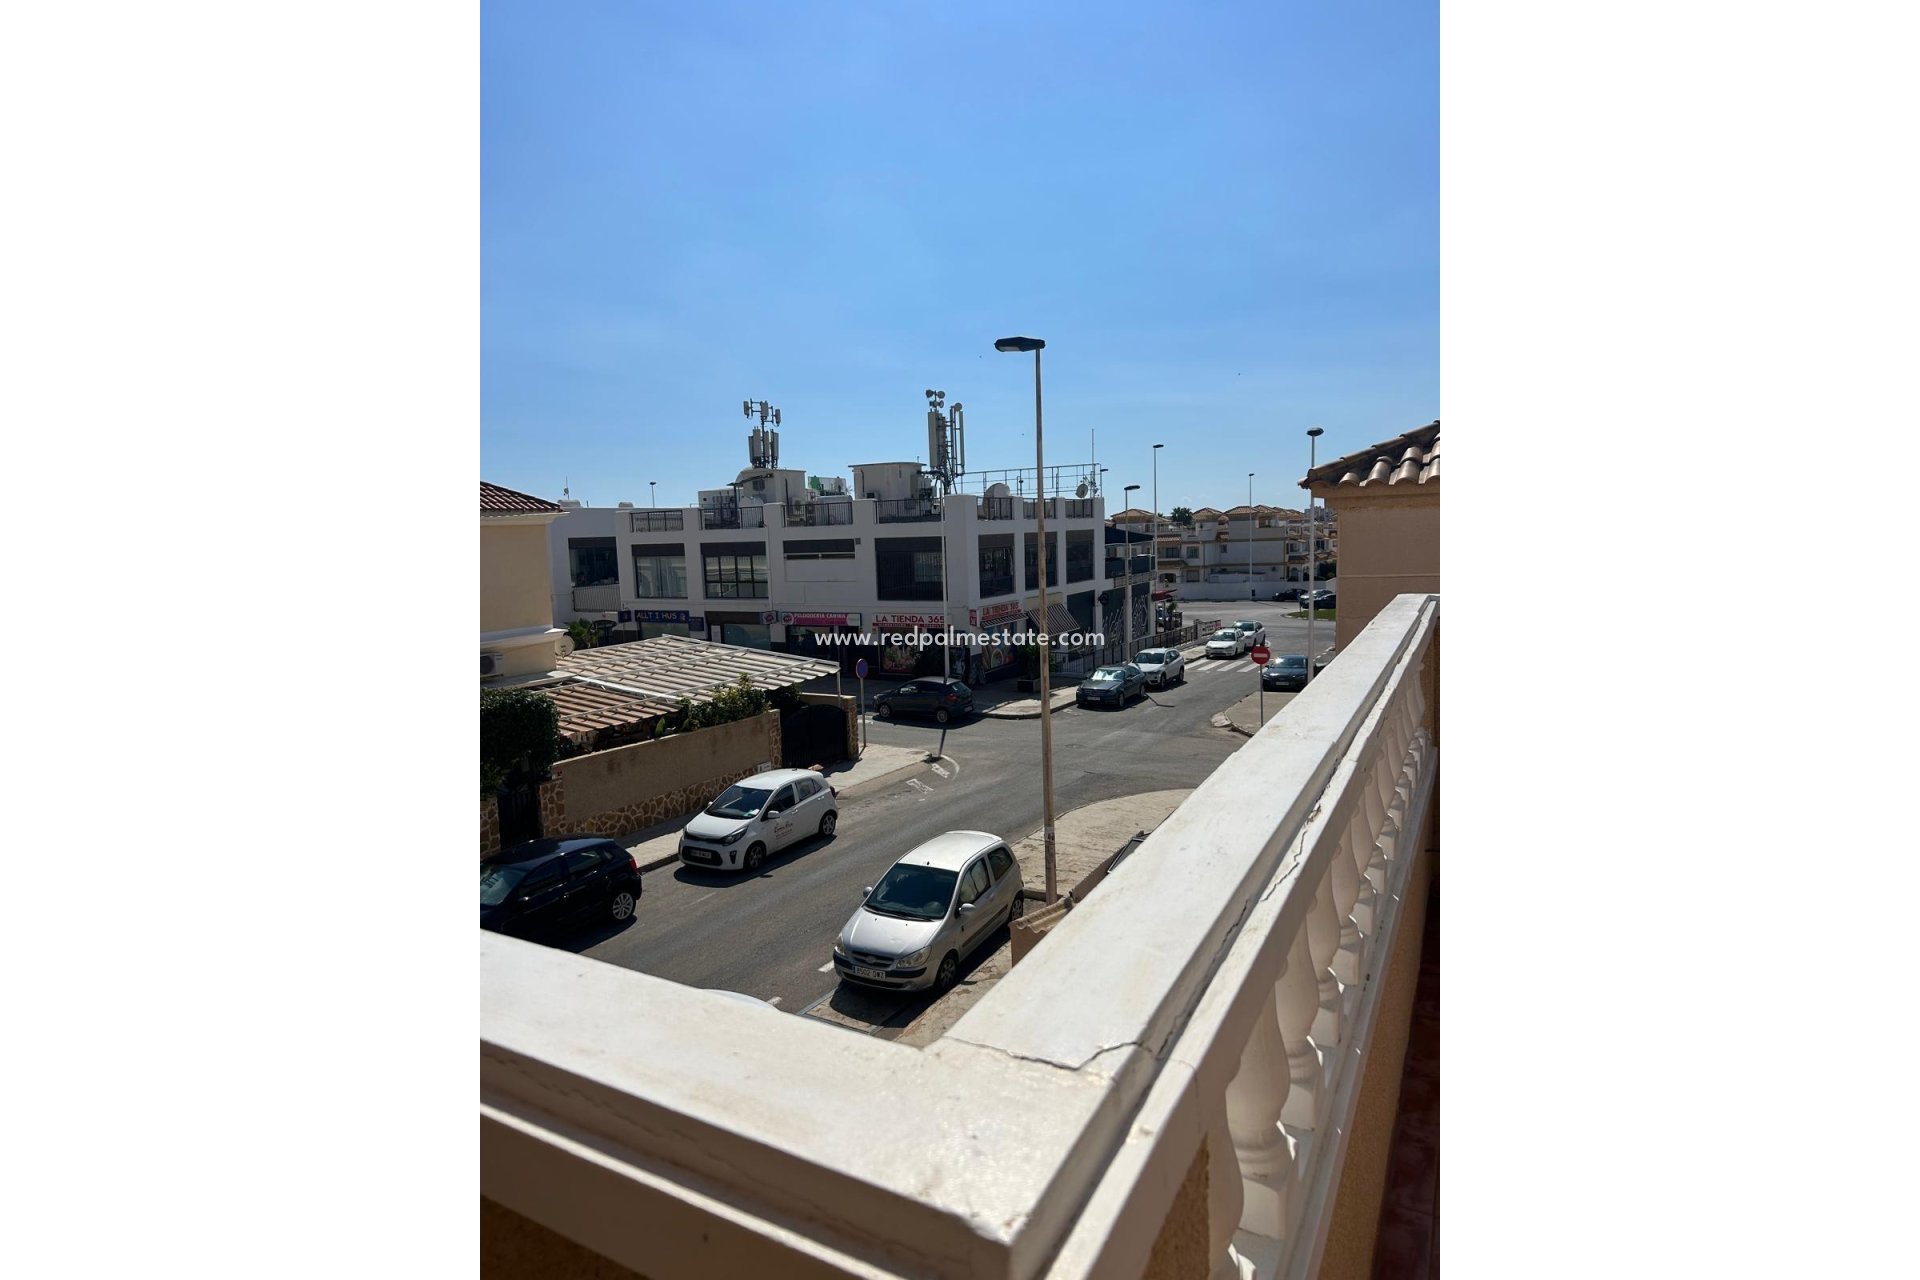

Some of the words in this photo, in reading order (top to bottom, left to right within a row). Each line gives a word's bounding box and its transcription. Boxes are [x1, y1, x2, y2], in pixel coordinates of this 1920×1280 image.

[661, 612, 678, 620] HUS
[875, 615, 889, 623] LA
[891, 615, 925, 624] TIENDA
[927, 615, 945, 624] 365
